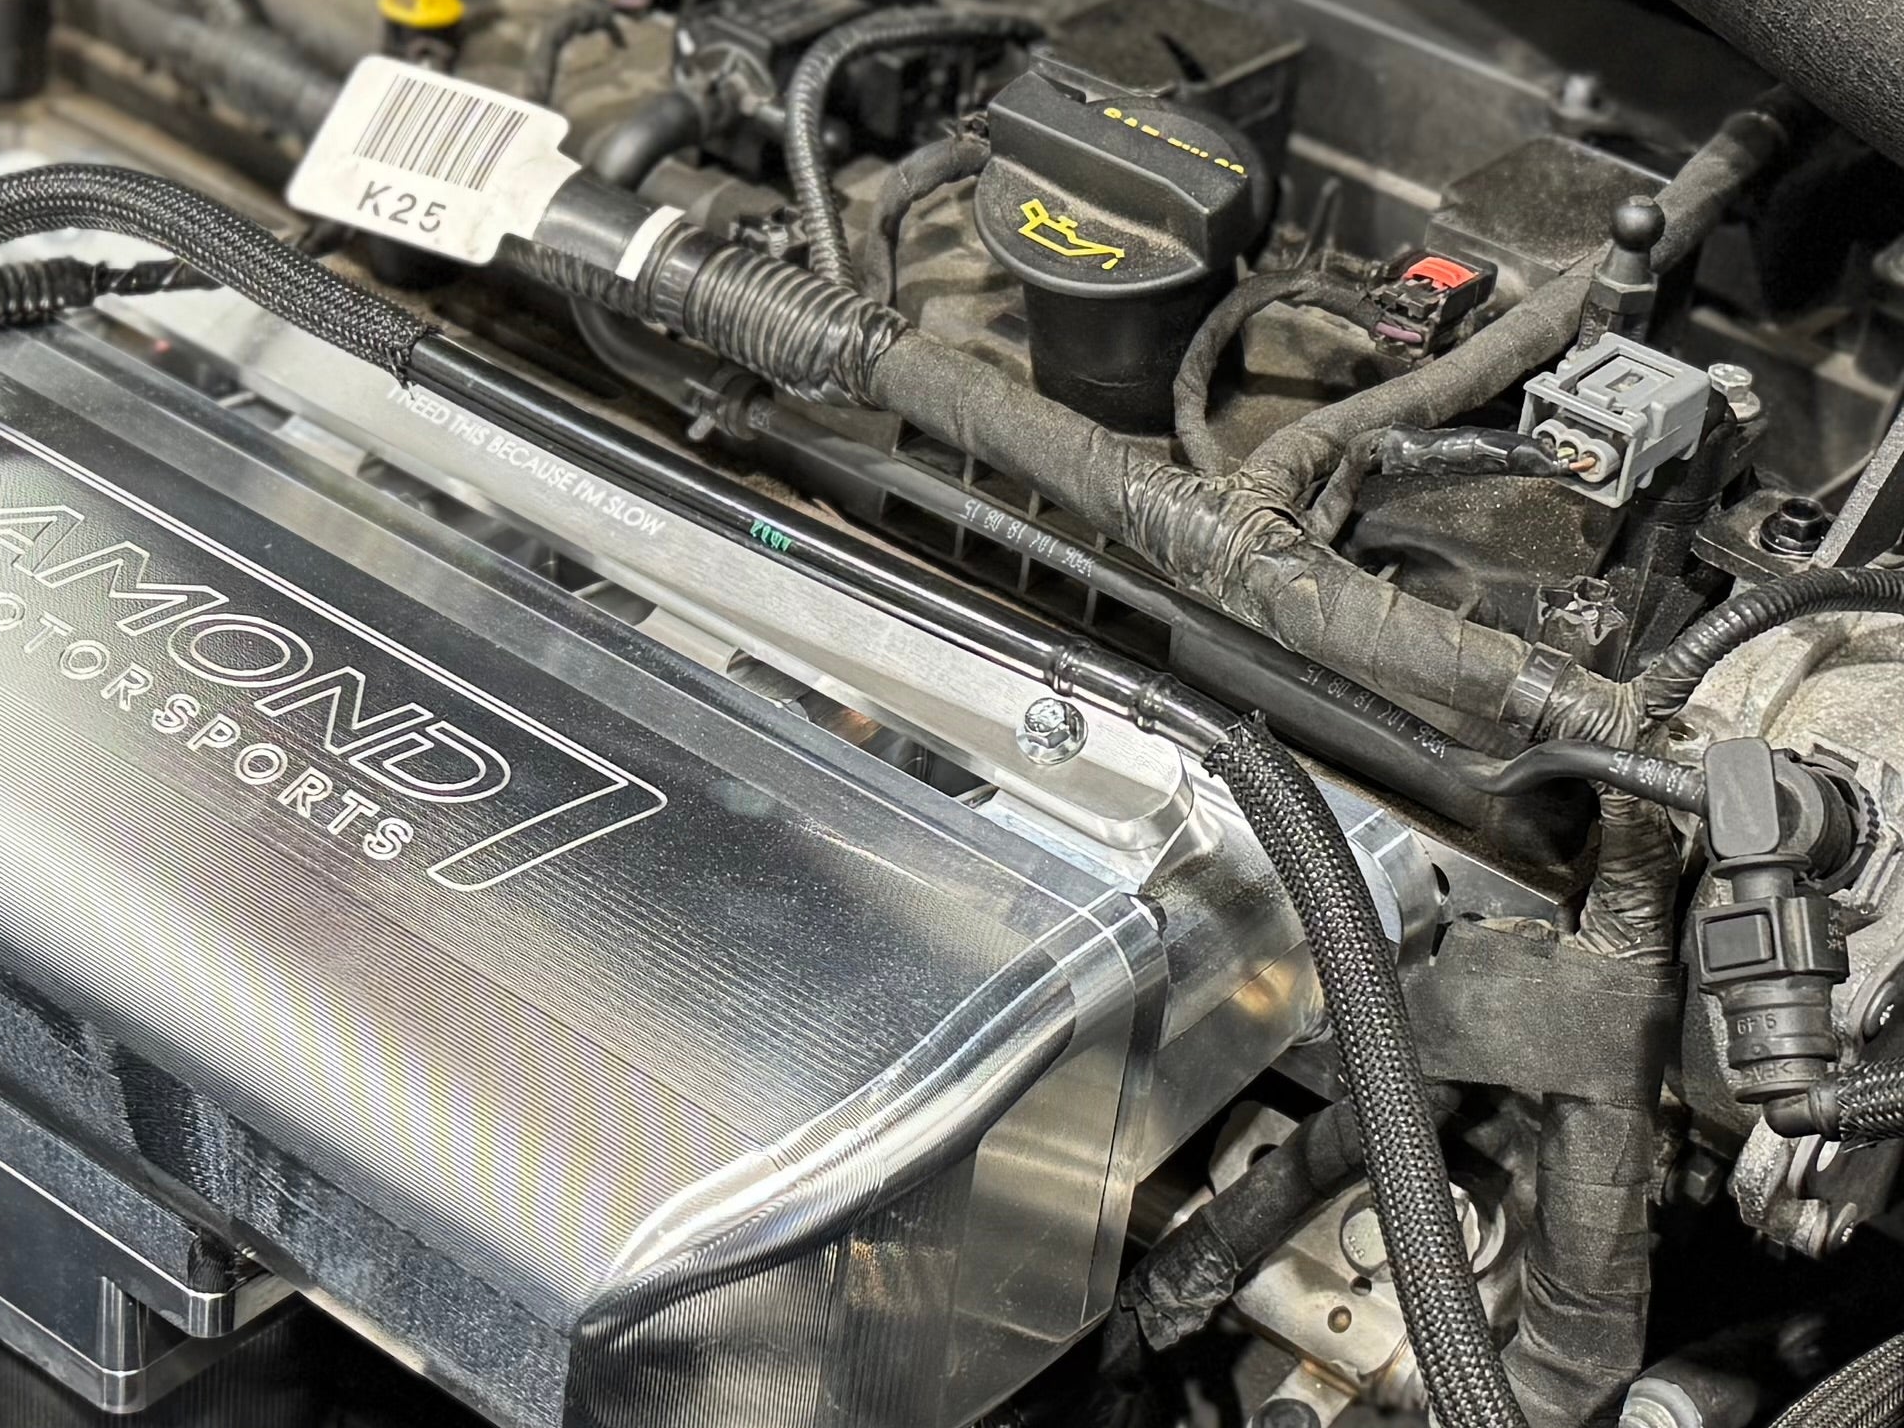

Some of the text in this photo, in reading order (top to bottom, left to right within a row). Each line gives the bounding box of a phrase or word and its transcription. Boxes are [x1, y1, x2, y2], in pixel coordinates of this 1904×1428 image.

[357, 180, 447, 234] K25
[447, 410, 490, 447] THIS
[486, 432, 583, 492] BECAUSE
[571, 476, 604, 510] I'M
[603, 493, 667, 537] SLOW
